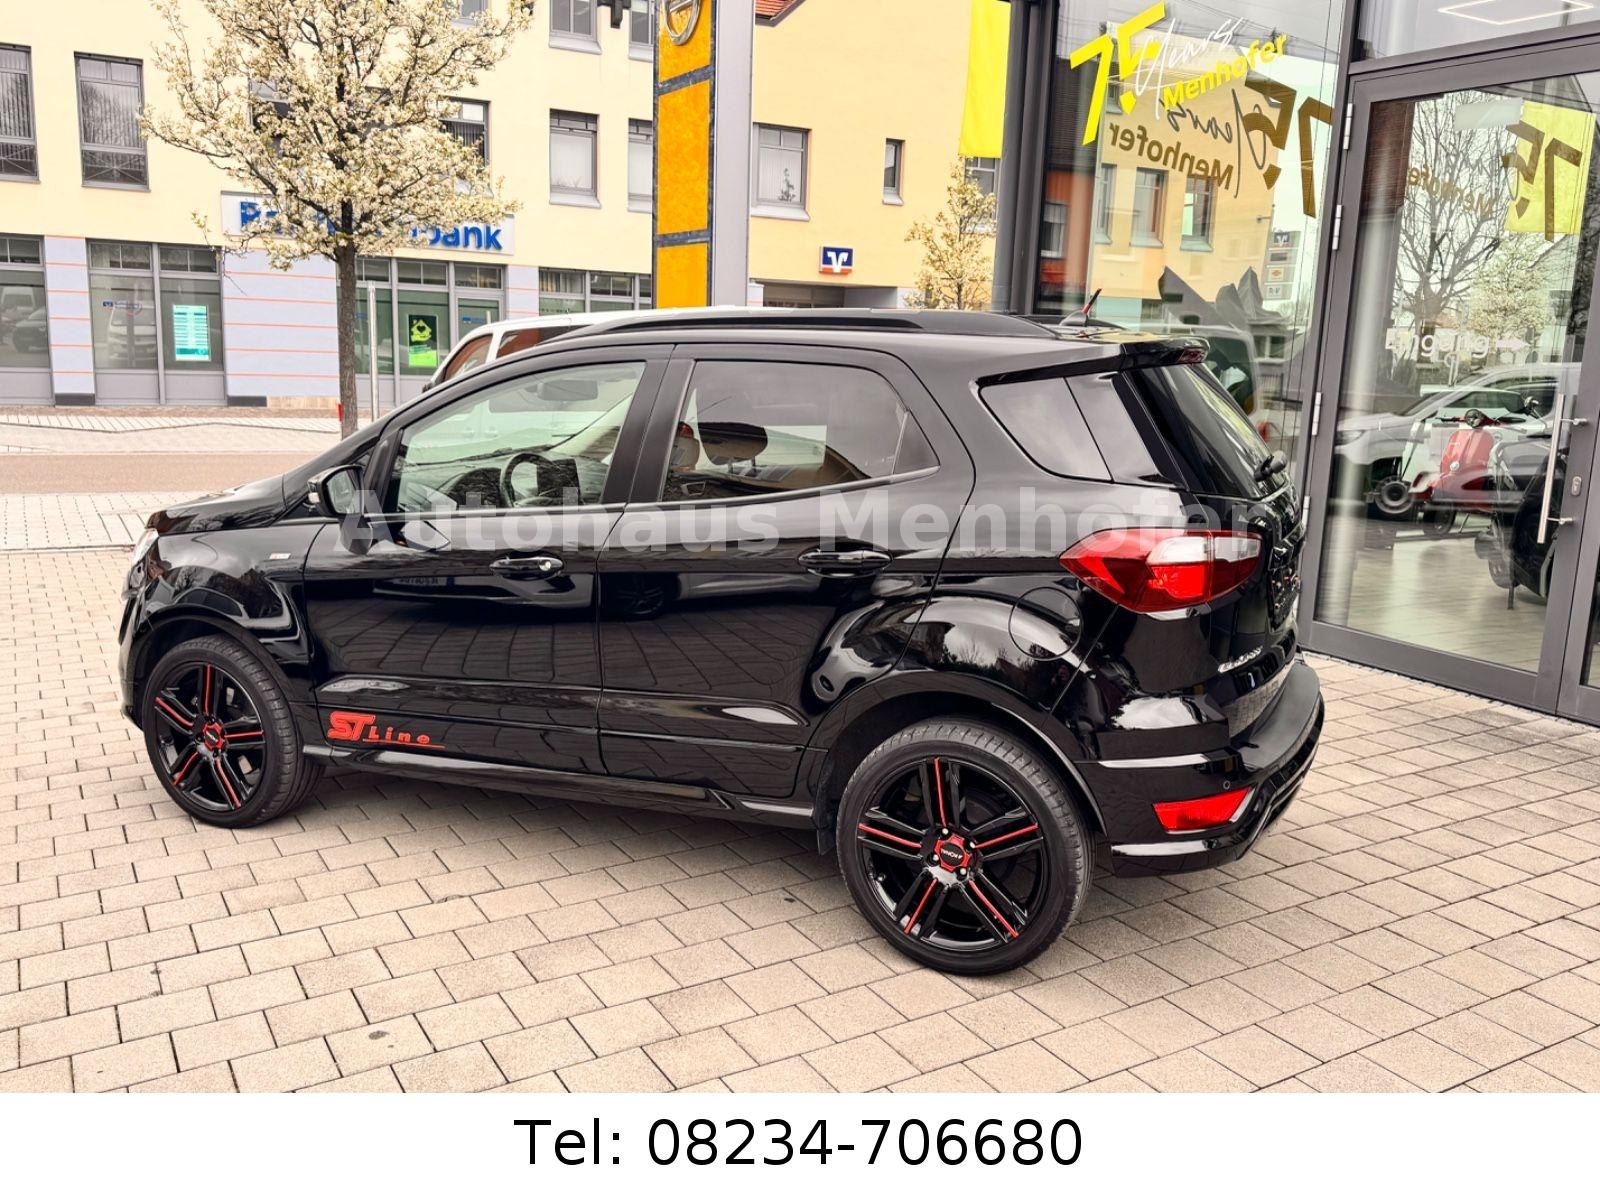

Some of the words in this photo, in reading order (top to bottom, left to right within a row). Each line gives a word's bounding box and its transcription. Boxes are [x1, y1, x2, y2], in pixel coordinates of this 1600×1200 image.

[1070, 2, 1166, 146] 75
[1162, 33, 1288, 111] Menhofer
[327, 710, 376, 741] ST
[368, 725, 430, 745] Line
